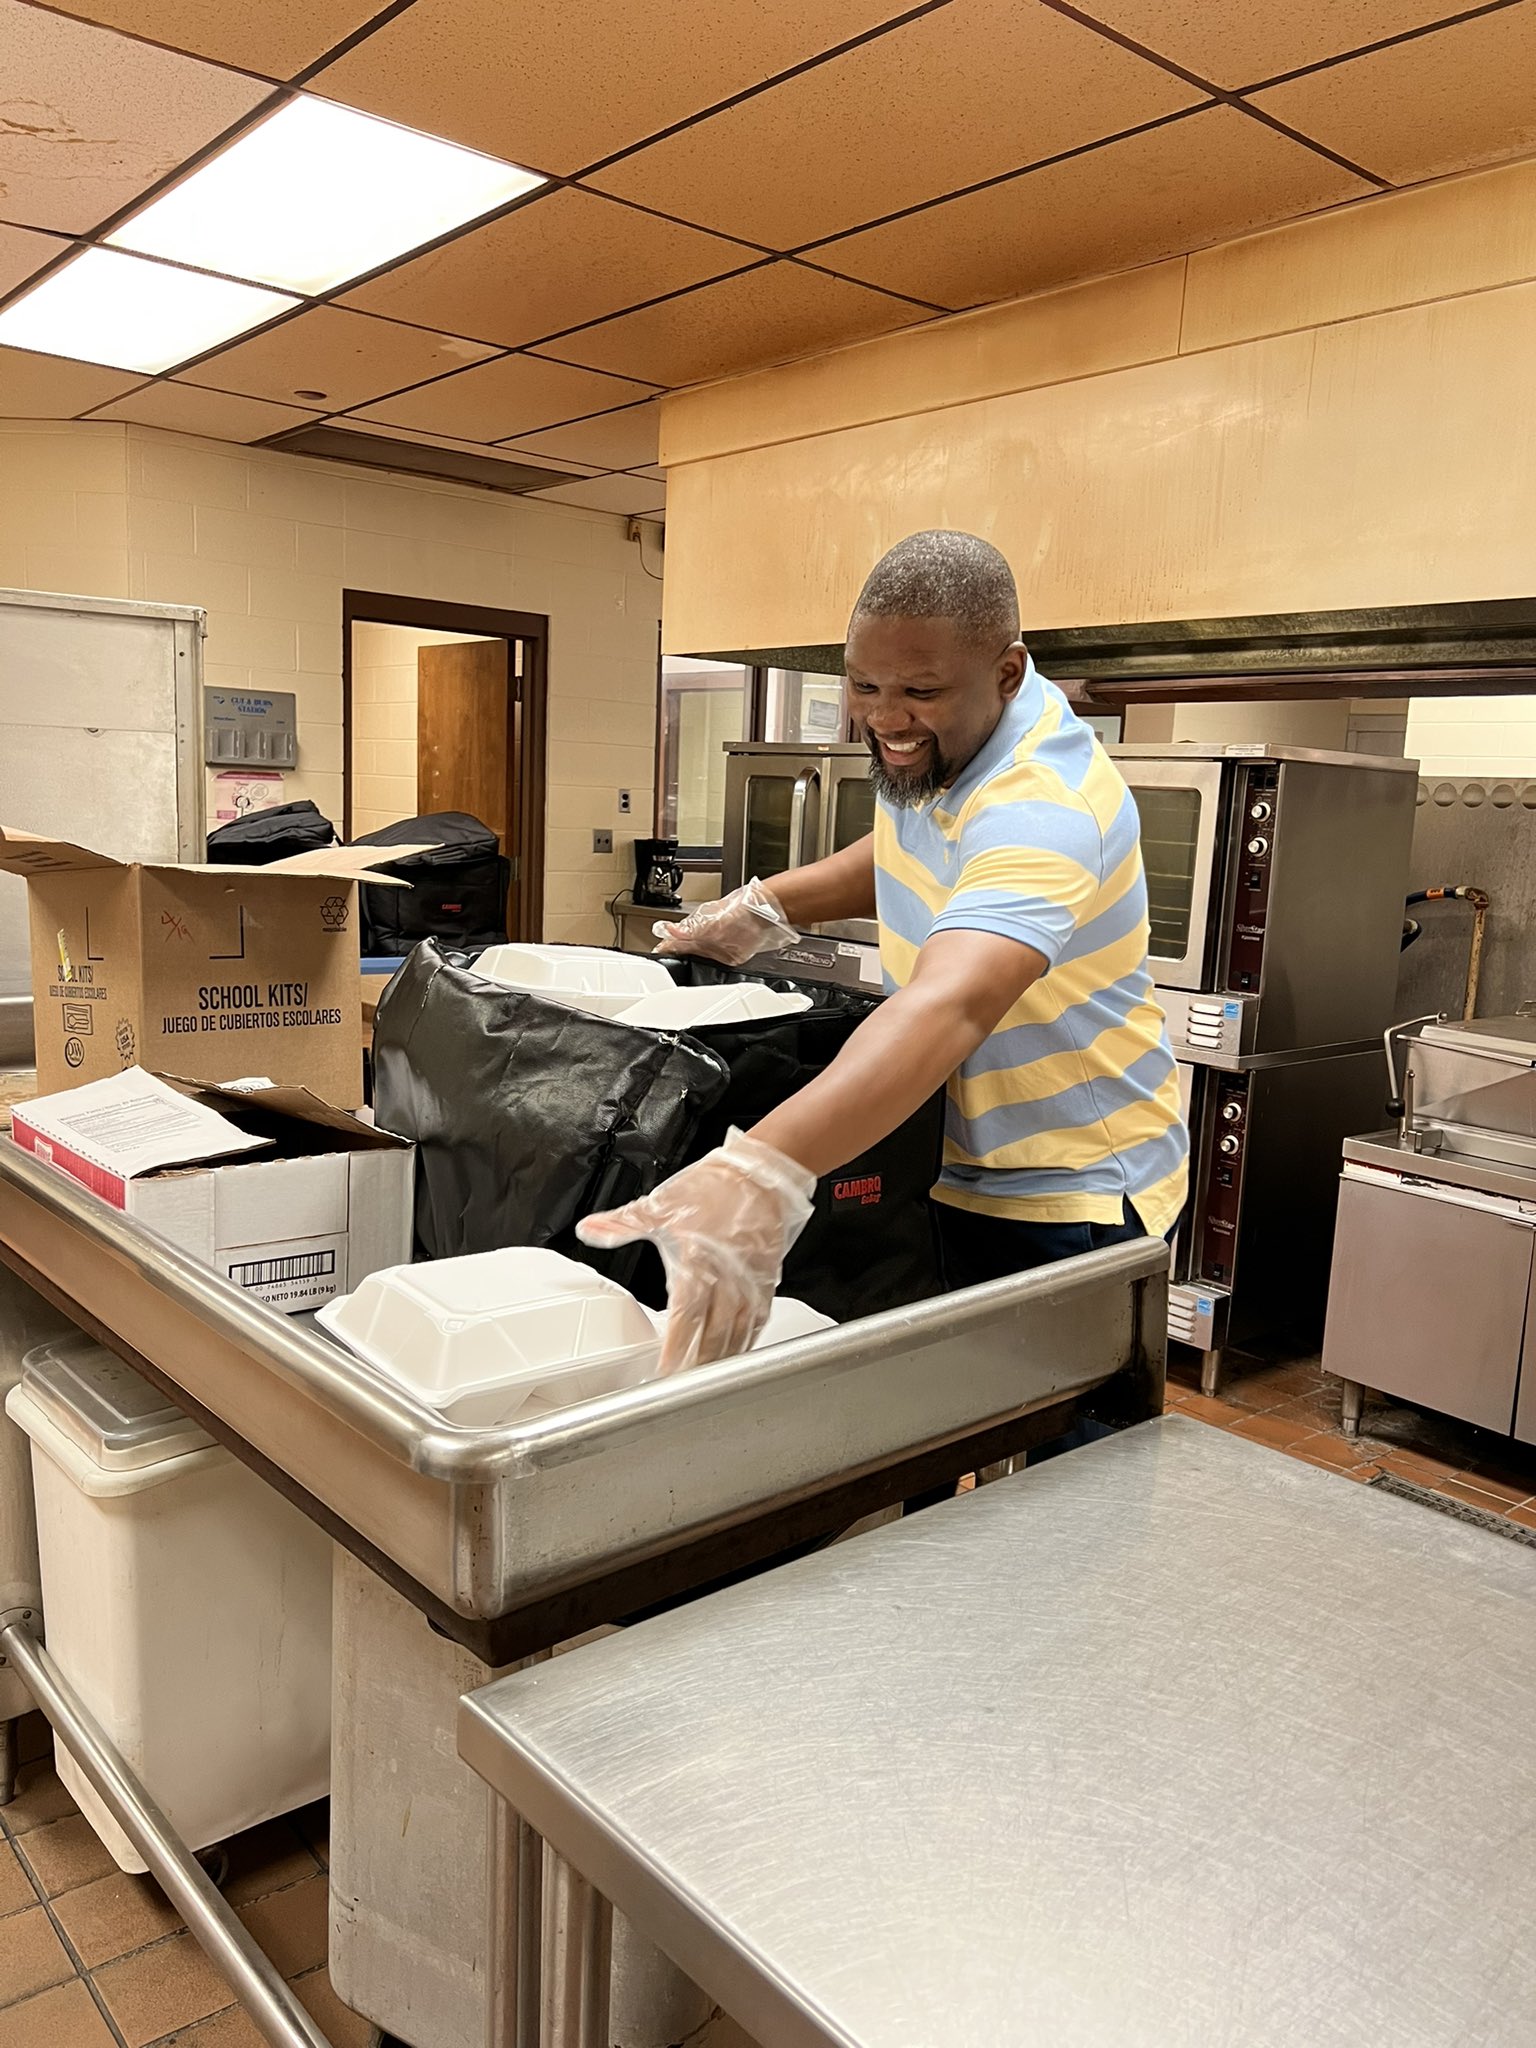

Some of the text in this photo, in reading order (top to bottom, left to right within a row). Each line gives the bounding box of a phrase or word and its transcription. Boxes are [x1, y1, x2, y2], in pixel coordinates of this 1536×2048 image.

[238, 706, 266, 714] STATION
[58, 965, 78, 982] SCOL
[198, 982, 308, 1010] SCHOOL KITS/
[162, 1008, 341, 1034] JUEGO DE CUBIERTOS ESCOLARES
[834, 1176, 881, 1200] CAMBRO
[271, 1292, 288, 1302] NETO
[290, 1290, 308, 1299] 19.84
[309, 1287, 317, 1295] LB
[325, 1284, 336, 1294] kg)
